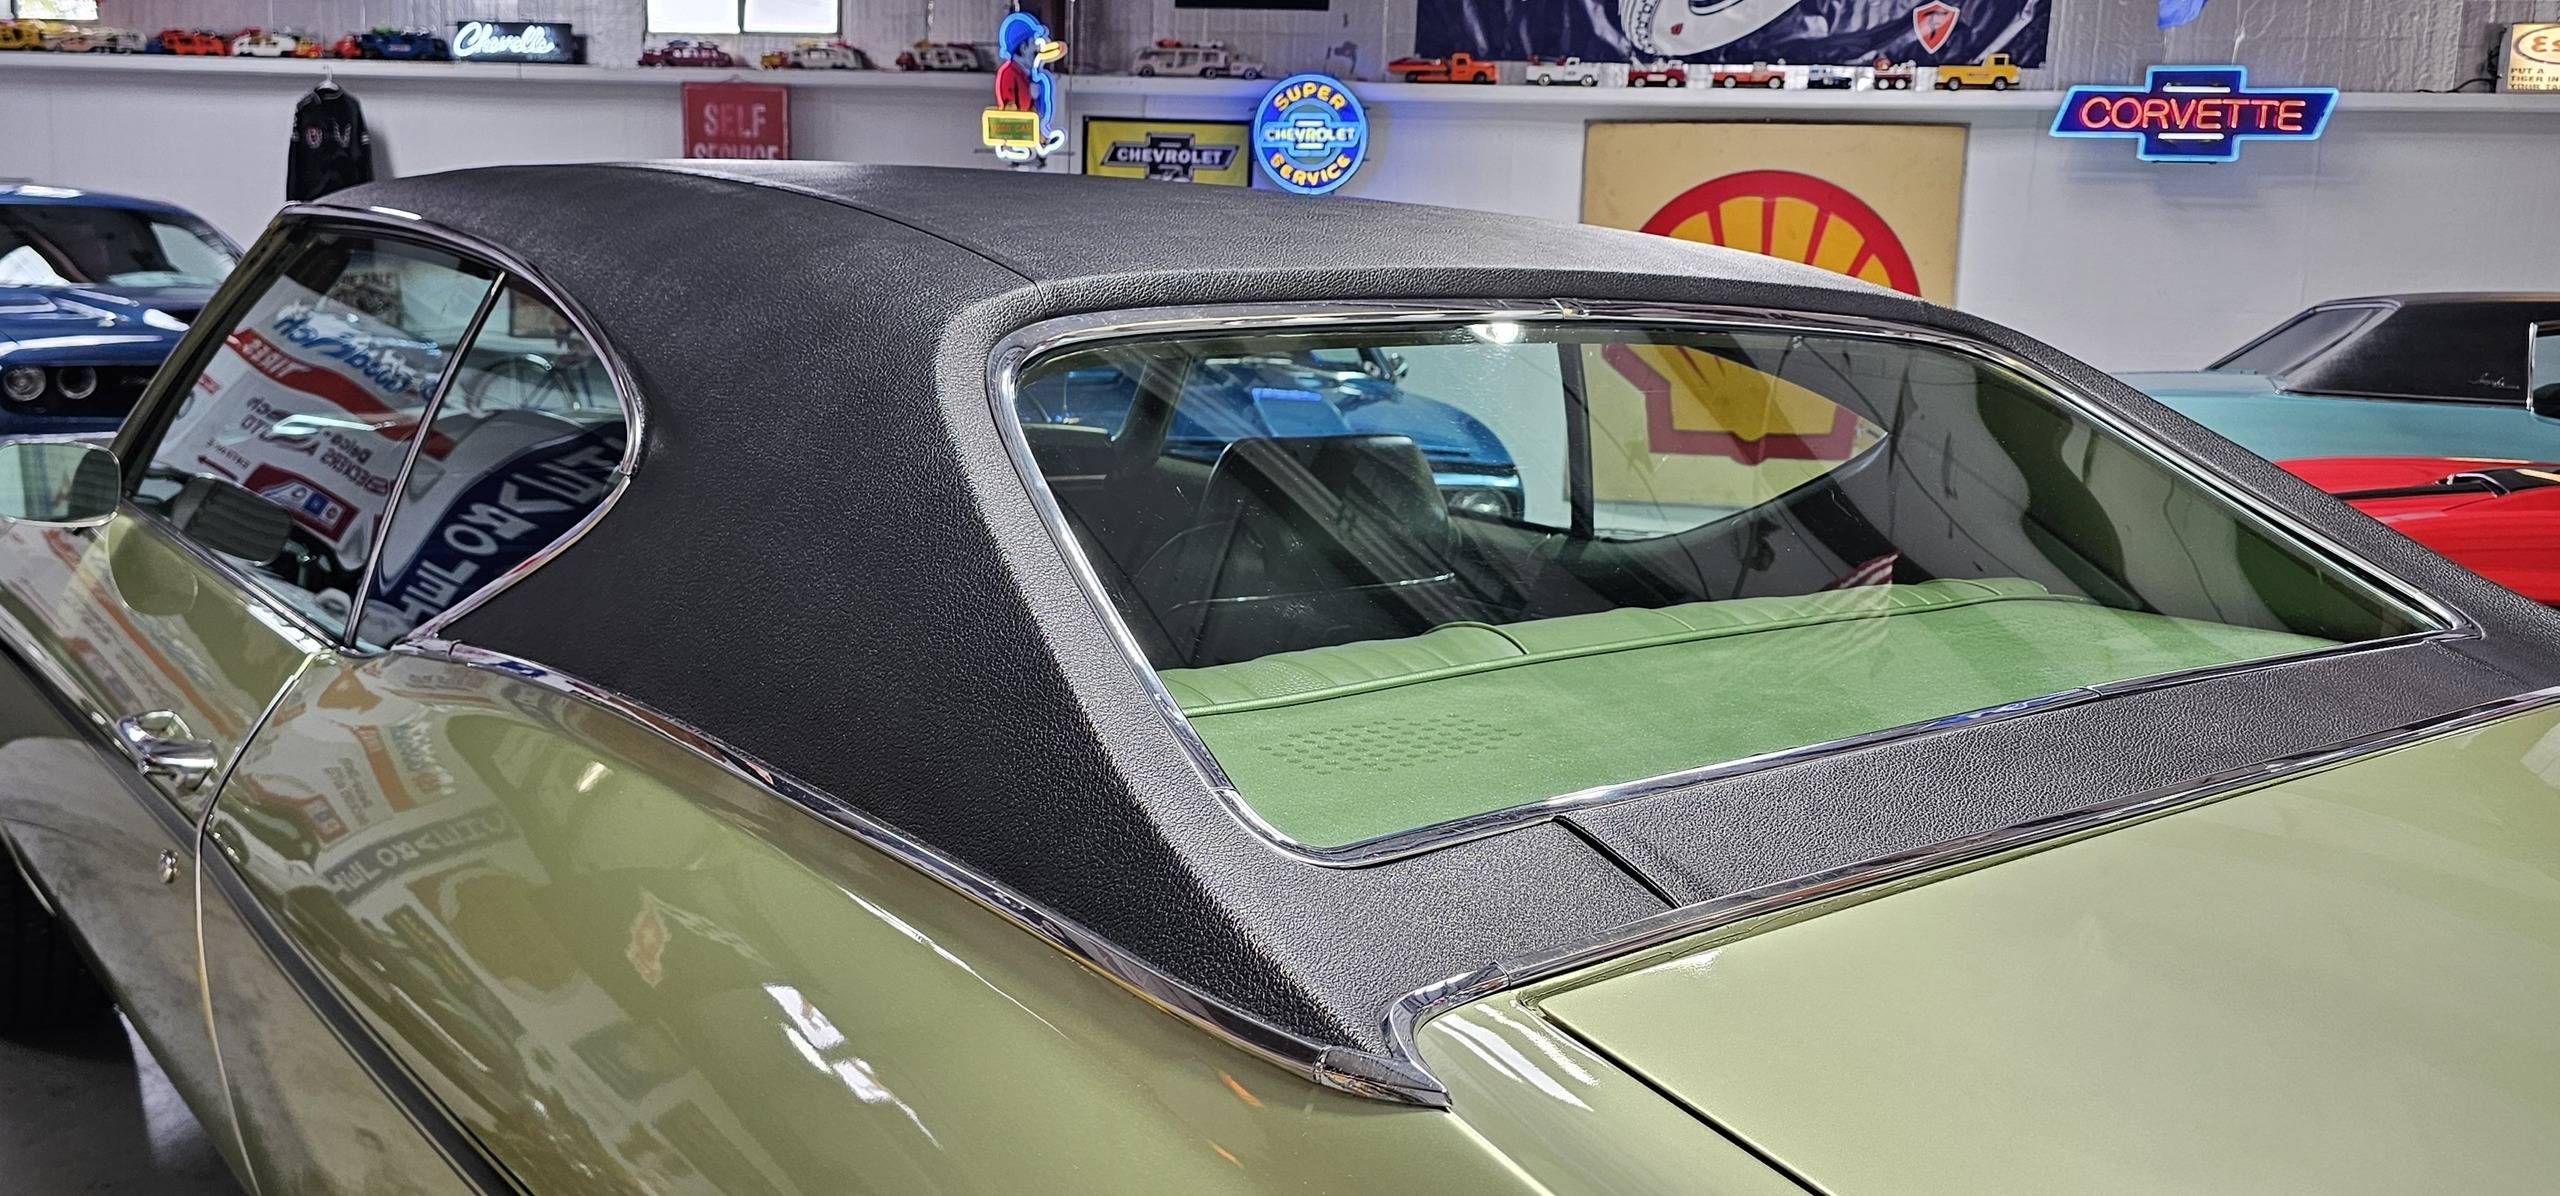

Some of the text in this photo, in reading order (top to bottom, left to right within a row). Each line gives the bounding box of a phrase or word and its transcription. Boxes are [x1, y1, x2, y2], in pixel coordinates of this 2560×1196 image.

[453, 21, 556, 57] Chevelle
[2510, 67, 2532, 75] PUT
[1273, 81, 1347, 111] SUPER
[703, 102, 767, 138] SELF
[2081, 96, 2307, 131] CORVETTE
[1263, 127, 1356, 143] CHEVROLET
[1116, 147, 1224, 165] CHEVROLET
[1269, 152, 1352, 186] SERVICE
